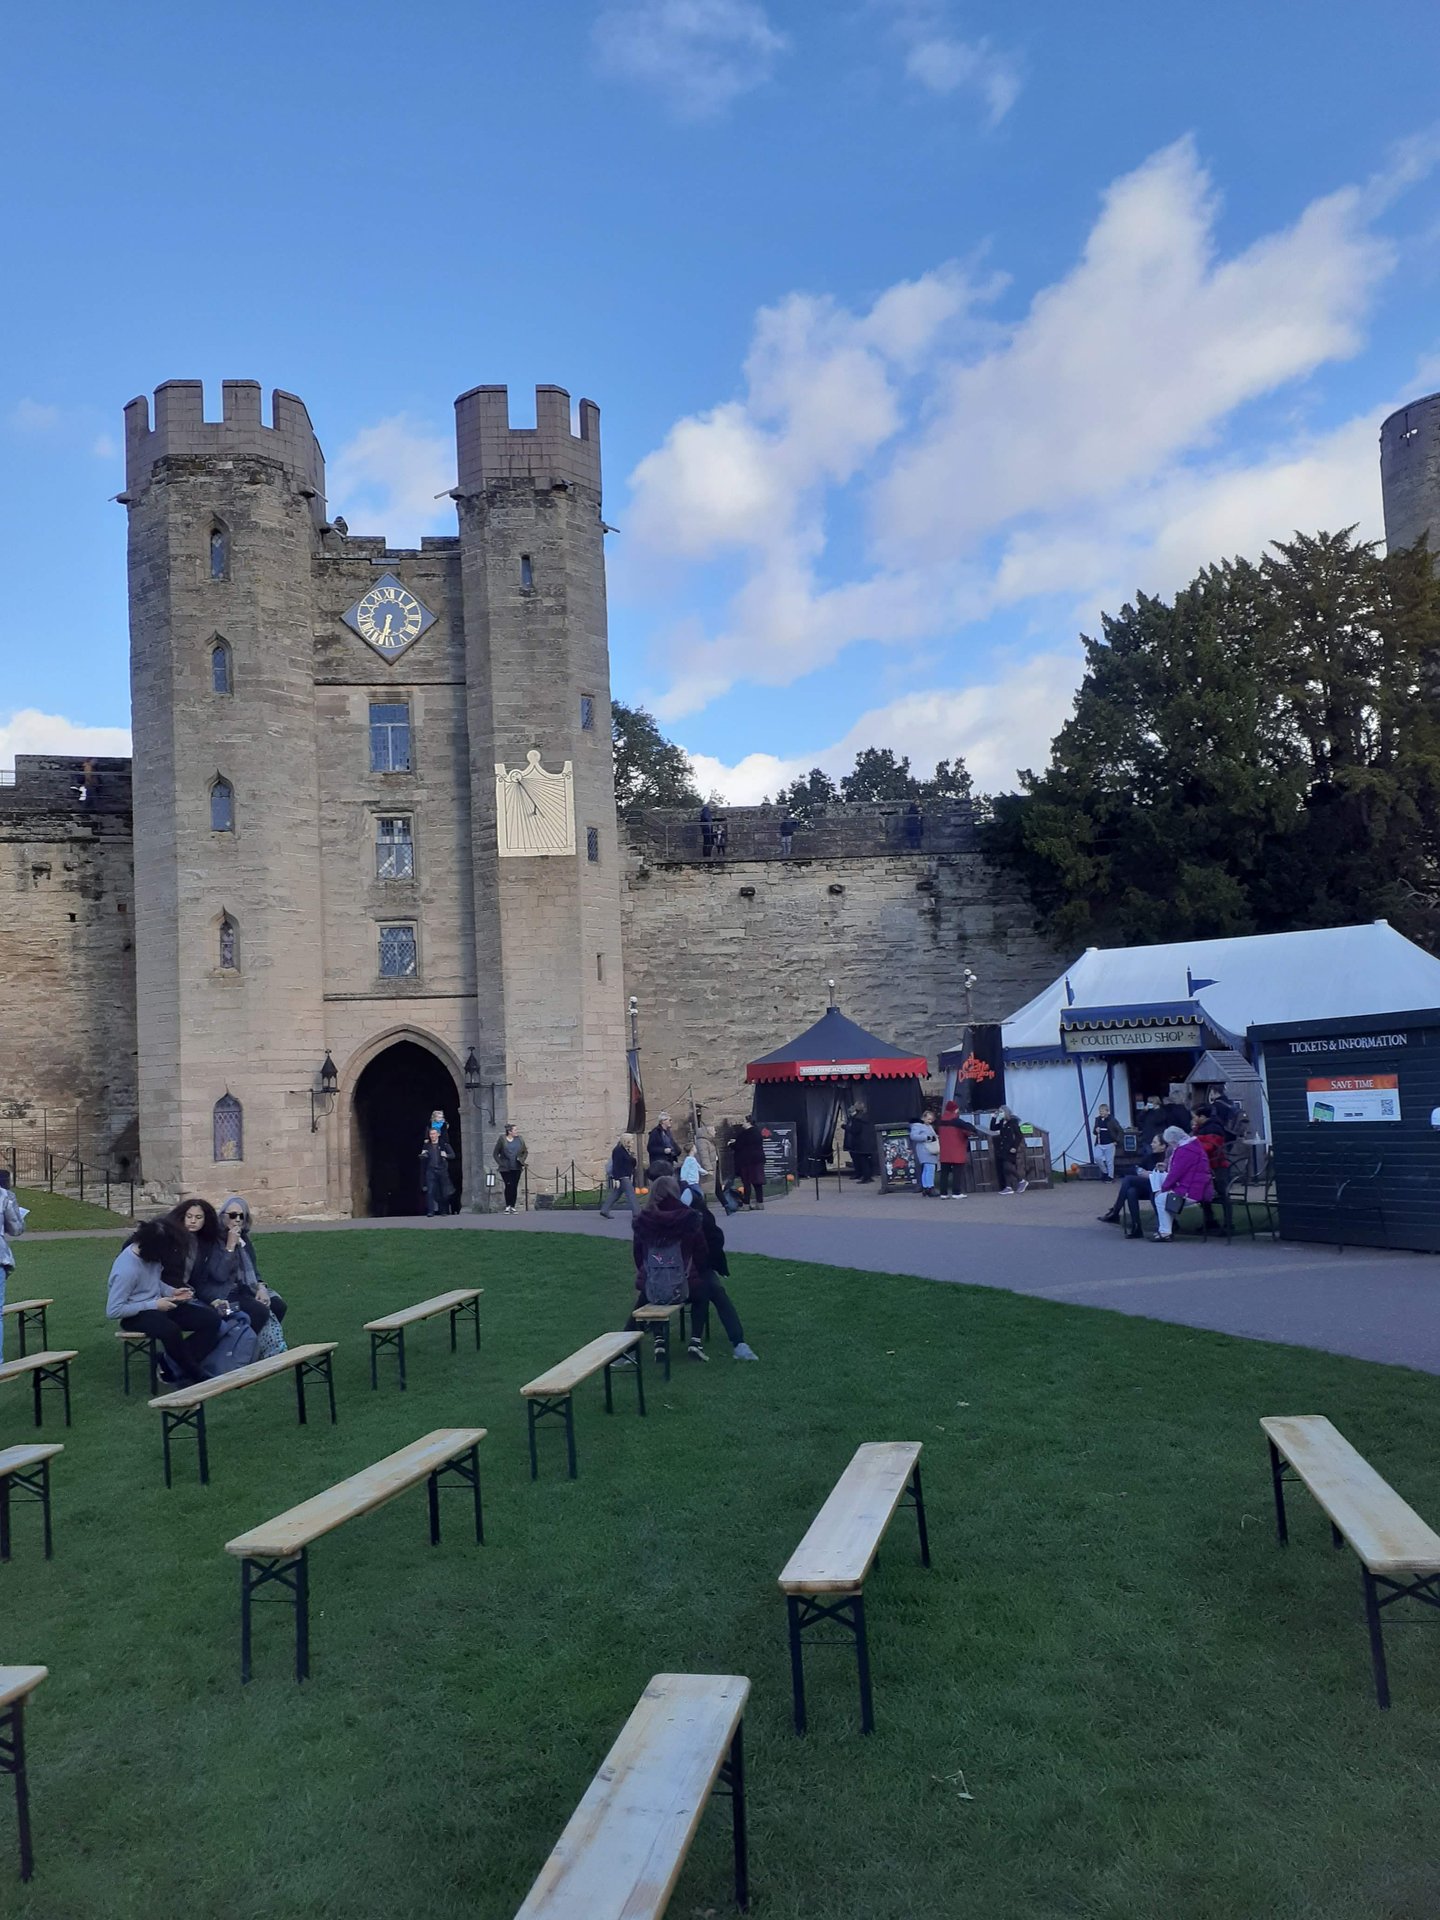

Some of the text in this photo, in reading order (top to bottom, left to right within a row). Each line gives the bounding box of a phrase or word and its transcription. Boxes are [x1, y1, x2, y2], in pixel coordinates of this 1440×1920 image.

[1081, 1031, 1184, 1046] COURTYARD SHOP
[1289, 1034, 1408, 1053] TICKETS & INFORMATION
[1331, 1079, 1374, 1090] SAVE TIME
